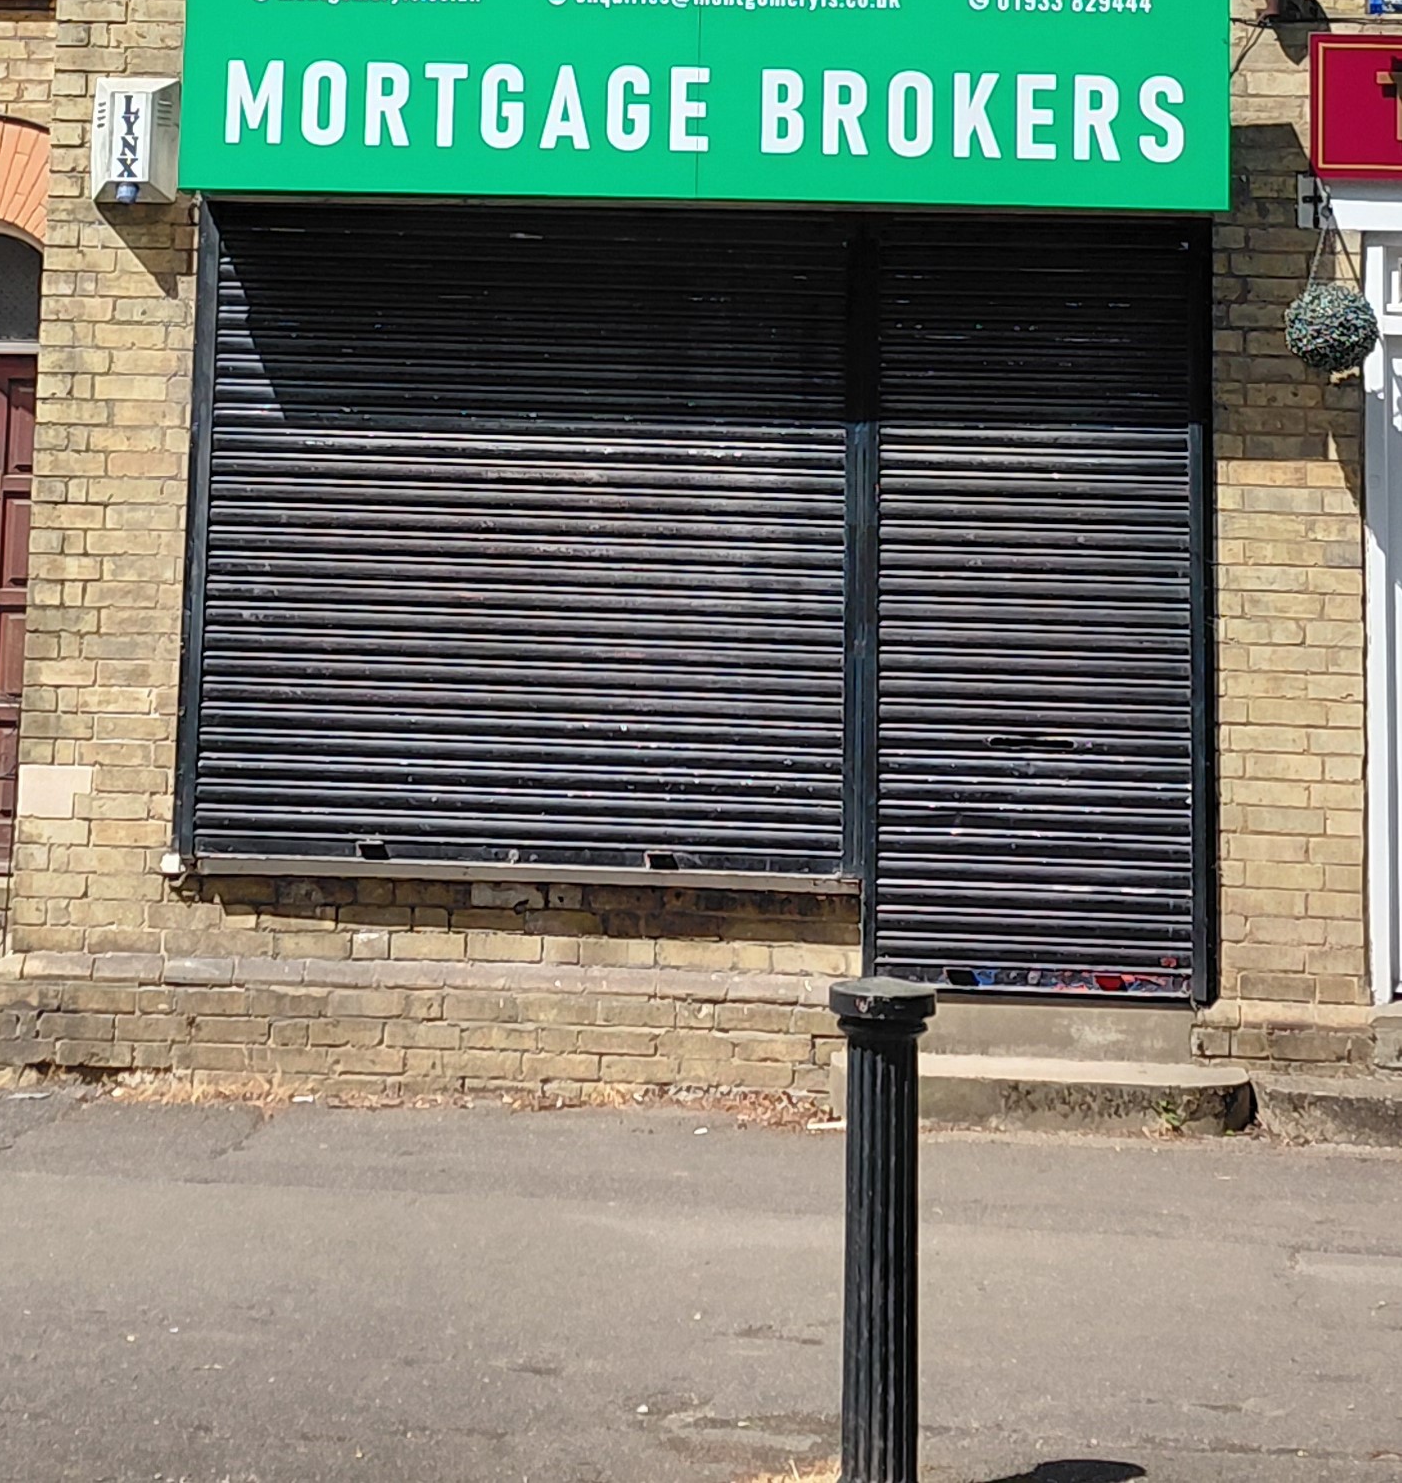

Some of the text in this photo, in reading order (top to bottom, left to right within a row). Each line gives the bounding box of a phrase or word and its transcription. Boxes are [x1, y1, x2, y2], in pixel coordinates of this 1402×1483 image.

[116, 94, 141, 178] LYNX
[225, 59, 1186, 163] MORTGAGE BROKERS
